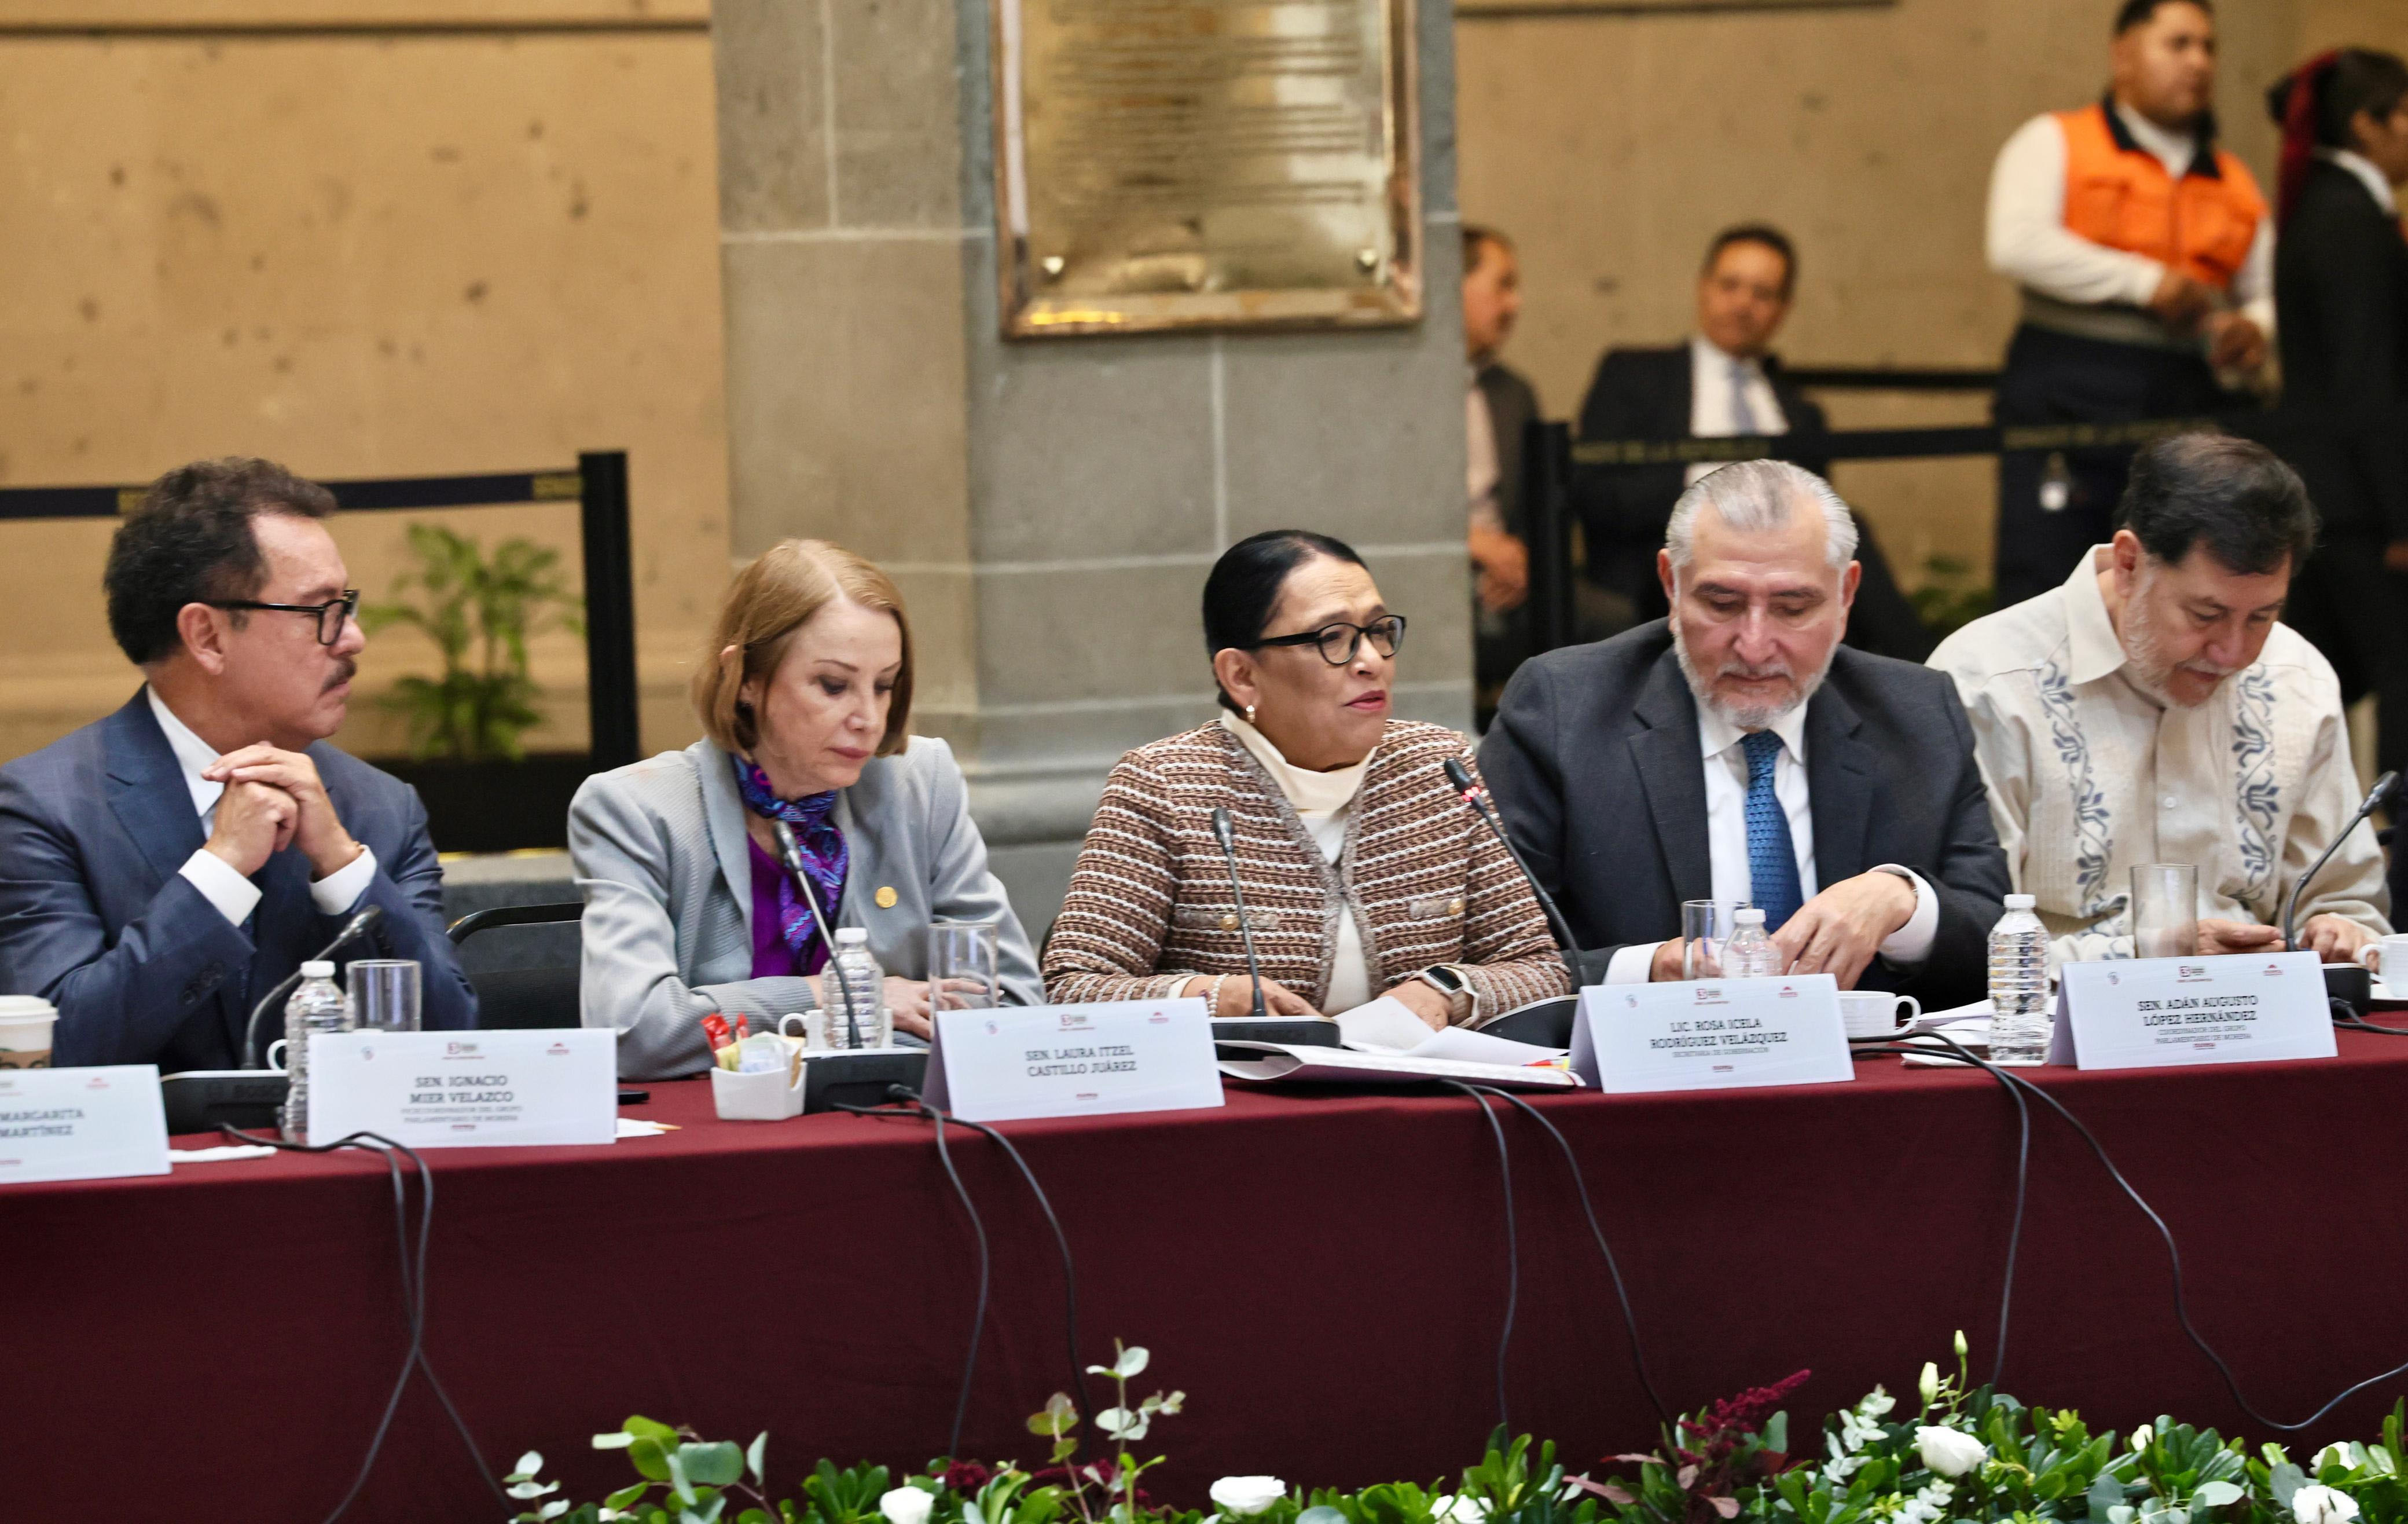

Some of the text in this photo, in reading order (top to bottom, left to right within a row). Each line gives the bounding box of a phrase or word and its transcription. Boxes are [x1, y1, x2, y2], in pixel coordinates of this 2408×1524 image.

[2166, 997, 2199, 1009] ADÁN
[2202, 995, 2258, 1008] AUGUSTO
[2143, 1010, 2257, 1026] LÓPEZ HERNÁNDEZ
[1695, 1020, 1726, 1031] ROSA
[1727, 1019, 1762, 1029] ICELA
[1649, 1032, 1787, 1049] RODRÍGUEZ VELÁZQUEZ
[1055, 1048, 1096, 1059] LAURA
[1099, 1046, 1135, 1057] ITZEL
[1027, 1060, 1137, 1076] CASTILLO JUÁREZ
[449, 1075, 508, 1087] IGNACIO
[410, 1091, 514, 1104] MIER VELAZCO
[0, 1109, 84, 1121] MARGARITA
[0, 1124, 74, 1137] MARTÍNEZ
